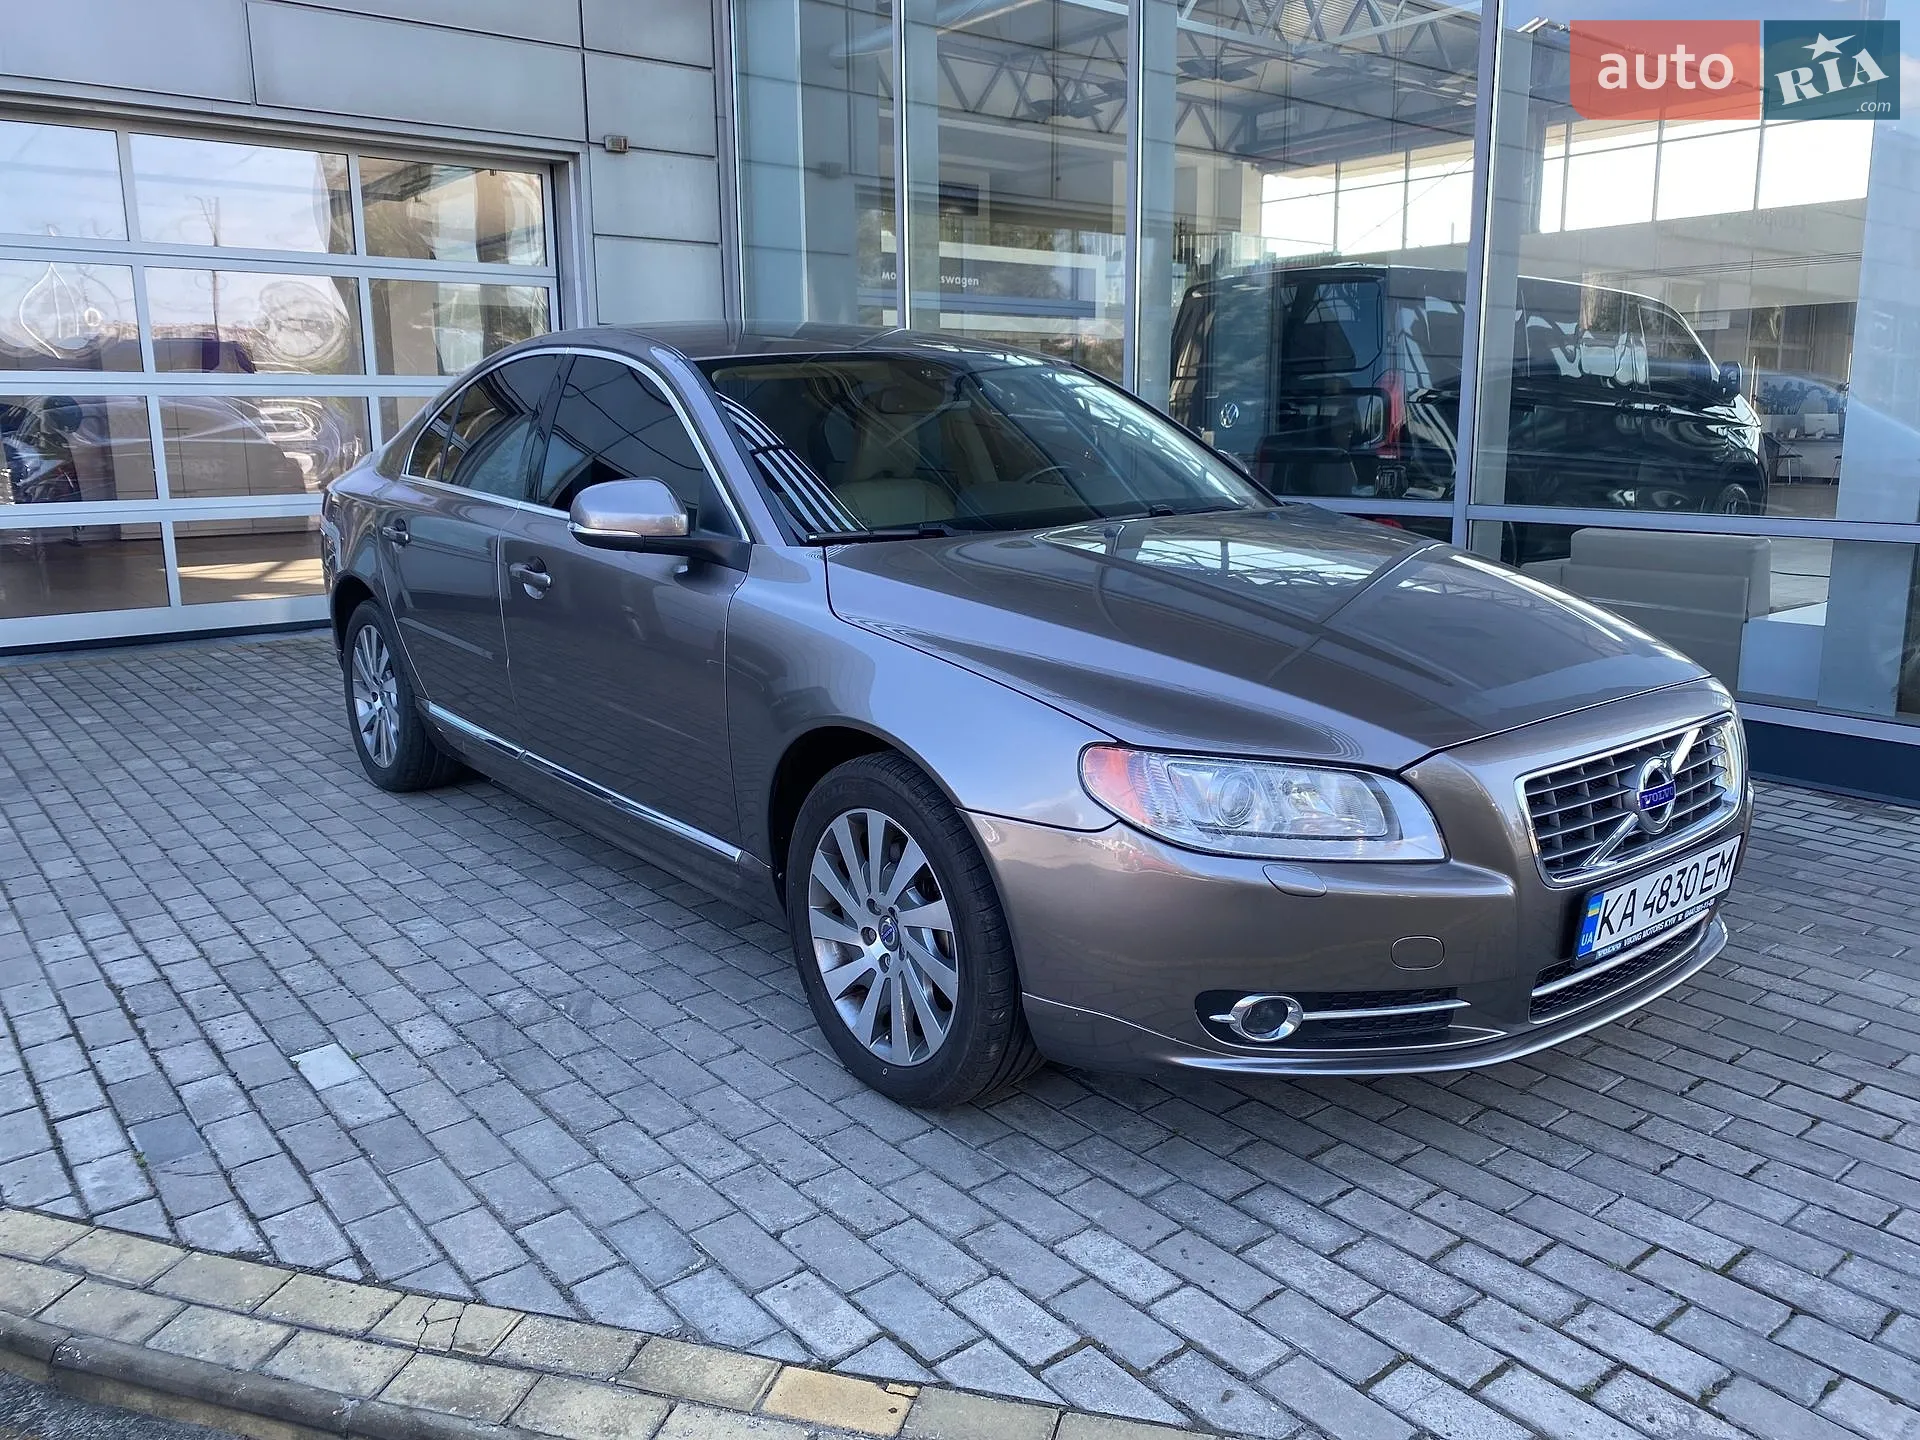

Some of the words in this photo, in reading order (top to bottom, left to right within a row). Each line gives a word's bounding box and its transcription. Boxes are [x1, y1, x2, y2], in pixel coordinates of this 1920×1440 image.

[940, 274, 979, 288] swagen
[1641, 786, 1674, 805] VOLVO
[1596, 888, 1637, 940] KA
[1642, 862, 1699, 918] 4830
[1699, 844, 1736, 896] EM
[1581, 932, 1593, 946] UA
